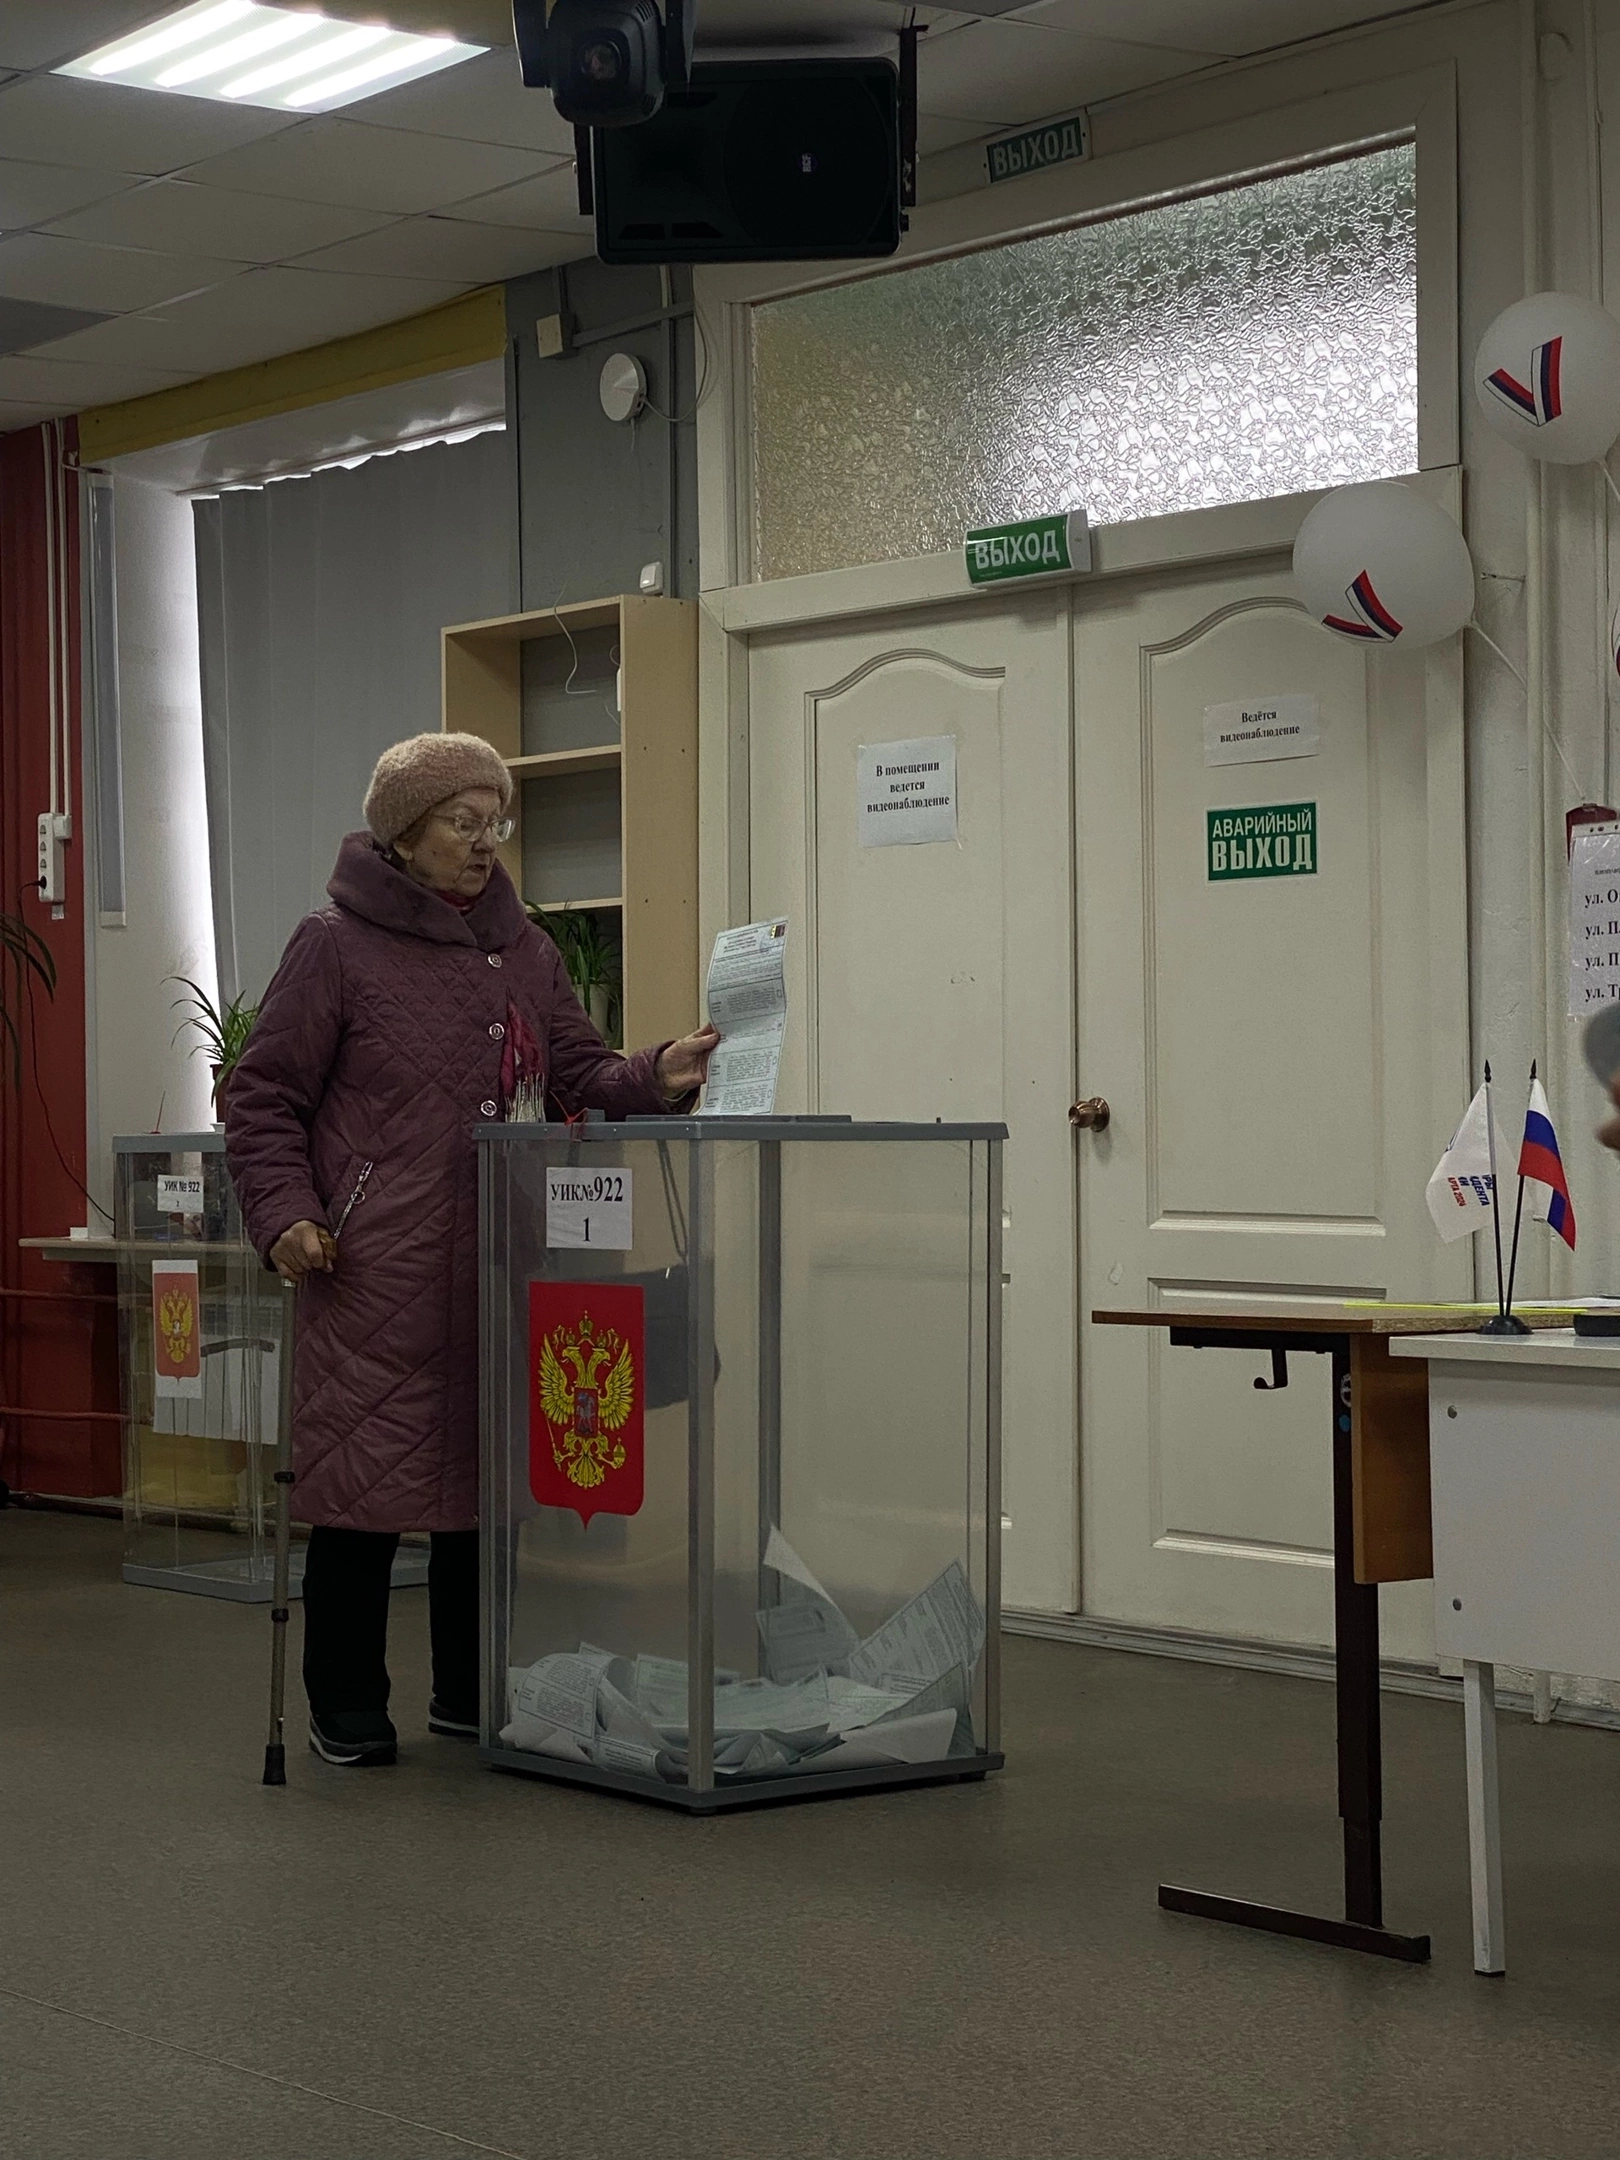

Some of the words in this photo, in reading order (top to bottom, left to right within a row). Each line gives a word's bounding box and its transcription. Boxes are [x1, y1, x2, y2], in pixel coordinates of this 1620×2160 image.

[992, 124, 1080, 177] ВЫХОД
[974, 530, 1061, 569] ВЫХОД
[1241, 711, 1277, 723] Ведётся
[1220, 725, 1300, 743] видеонаблюдение
[876, 765, 883, 777] В
[885, 762, 940, 776] помещении
[890, 781, 925, 793] ведется
[867, 797, 950, 813] видеонаблюдение
[1212, 808, 1312, 838] АВАРИЙНЫЙ
[1212, 834, 1313, 872] ВЫХОД
[1585, 894, 1603, 908] ул.
[1607, 889, 1620, 903] О
[1586, 926, 1604, 940] ул.
[1608, 921, 1620, 934] П
[1585, 957, 1604, 971] ул.
[1608, 952, 1619, 966] П
[1585, 989, 1604, 1002] ул.
[164, 1181, 178, 1192] УИК
[179, 1181, 187, 1192] №
[188, 1181, 200, 1193] 922
[551, 1176, 623, 1202] УИК№922
[583, 1217, 590, 1242] 1
